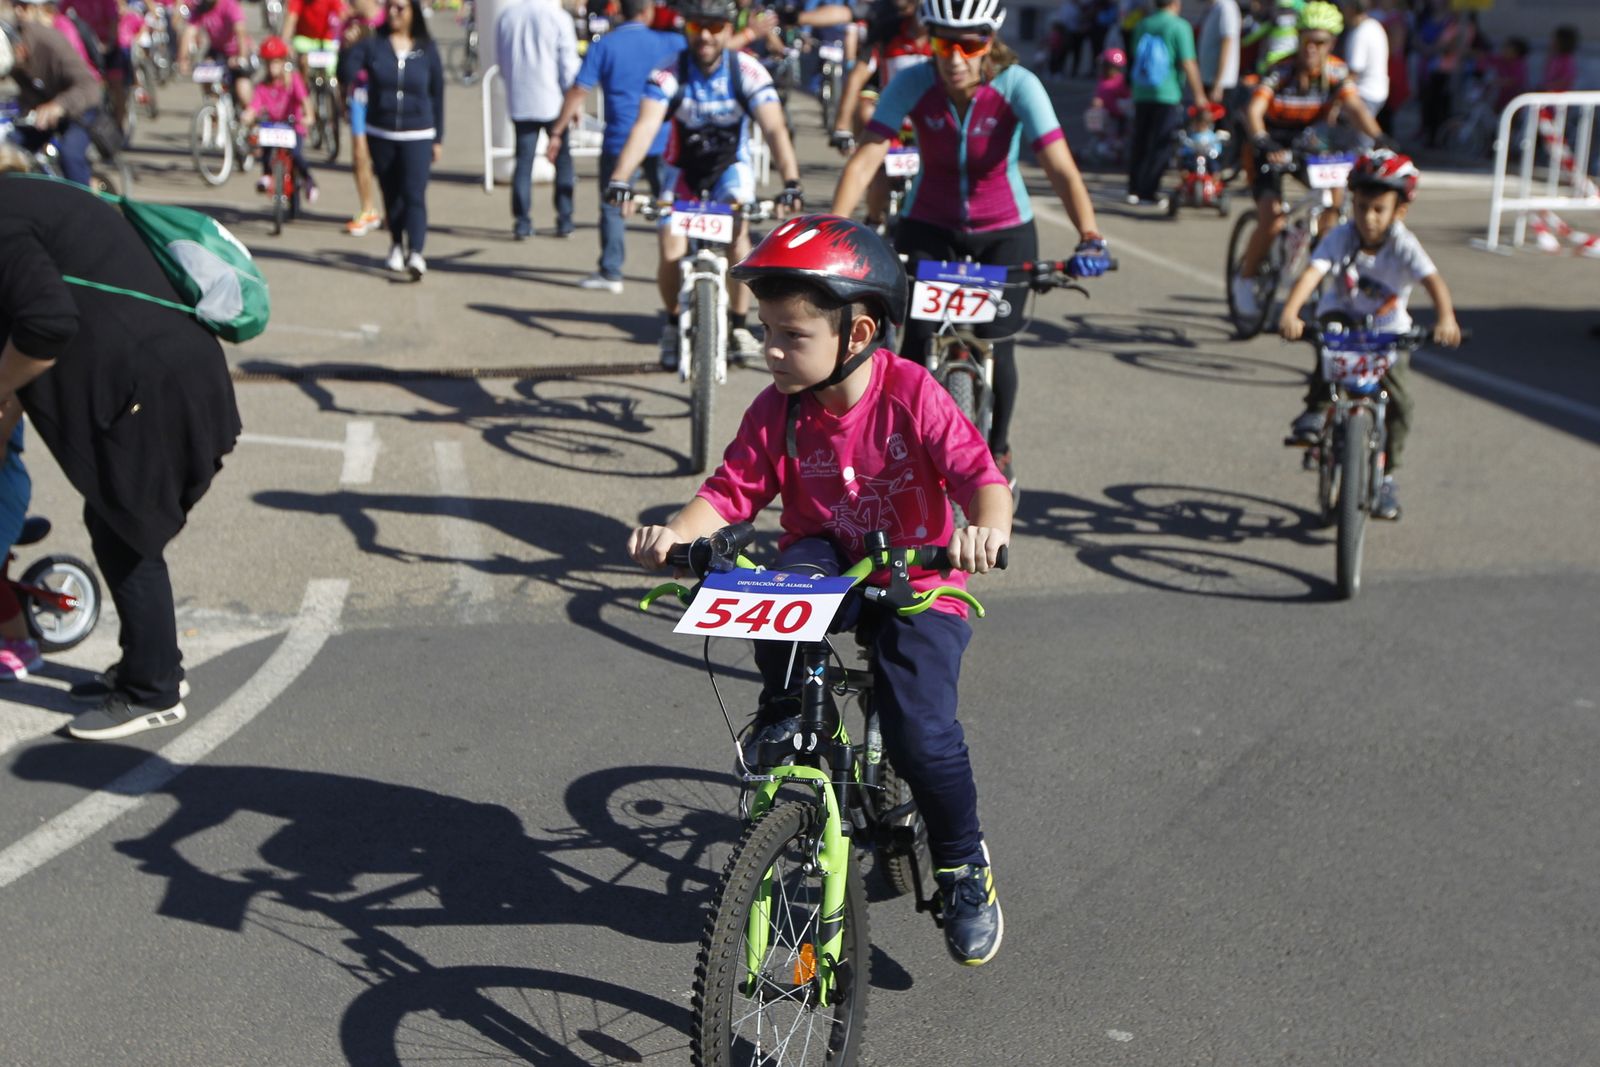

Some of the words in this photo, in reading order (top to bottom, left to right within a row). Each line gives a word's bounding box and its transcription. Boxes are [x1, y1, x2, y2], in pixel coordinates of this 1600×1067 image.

[679, 215, 722, 235] 449
[922, 285, 990, 317] 347
[695, 598, 812, 634] 540
